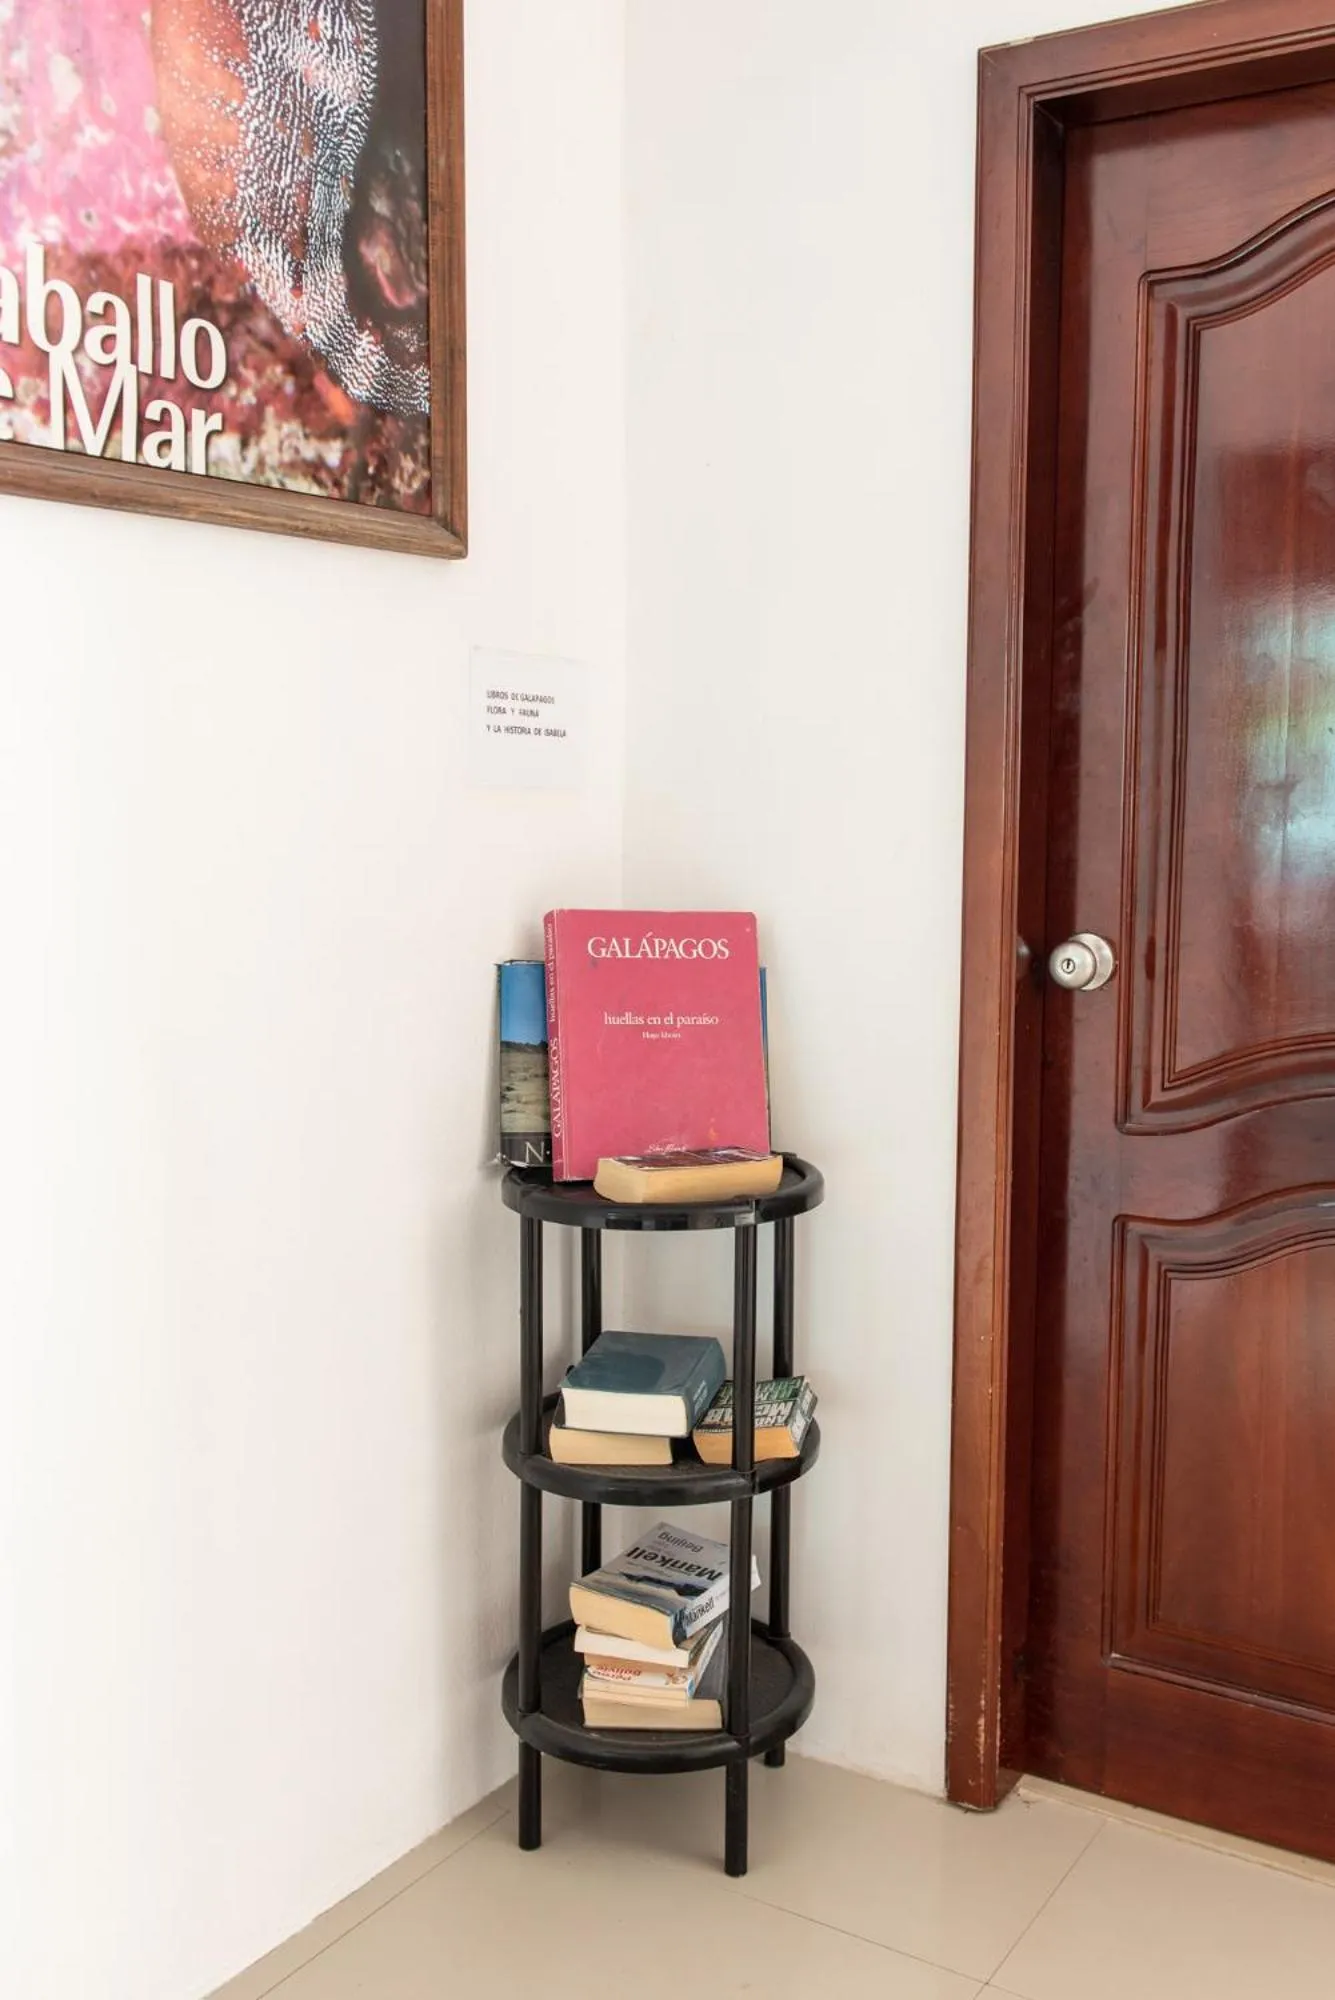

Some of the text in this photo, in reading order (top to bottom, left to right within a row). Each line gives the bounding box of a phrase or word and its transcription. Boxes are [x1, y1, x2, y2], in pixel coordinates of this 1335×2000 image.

[49, 346, 222, 474] Mar
[487, 690, 555, 704] LIBROS DE GALAPAGOS
[487, 706, 506, 715] FLORA
[519, 709, 539, 718] FAUNA
[493, 725, 501, 733] LA
[504, 726, 531, 735] HISTORIA
[534, 728, 542, 736] DE
[544, 729, 566, 738] ISABELA
[587, 932, 729, 960] GALÁPAGOS
[604, 1011, 719, 1029] huellas en el paraíso
[550, 1037, 562, 1138] GALÁPAGOS
[658, 1531, 704, 1553] Beijing
[625, 1547, 722, 1580] Mankell
